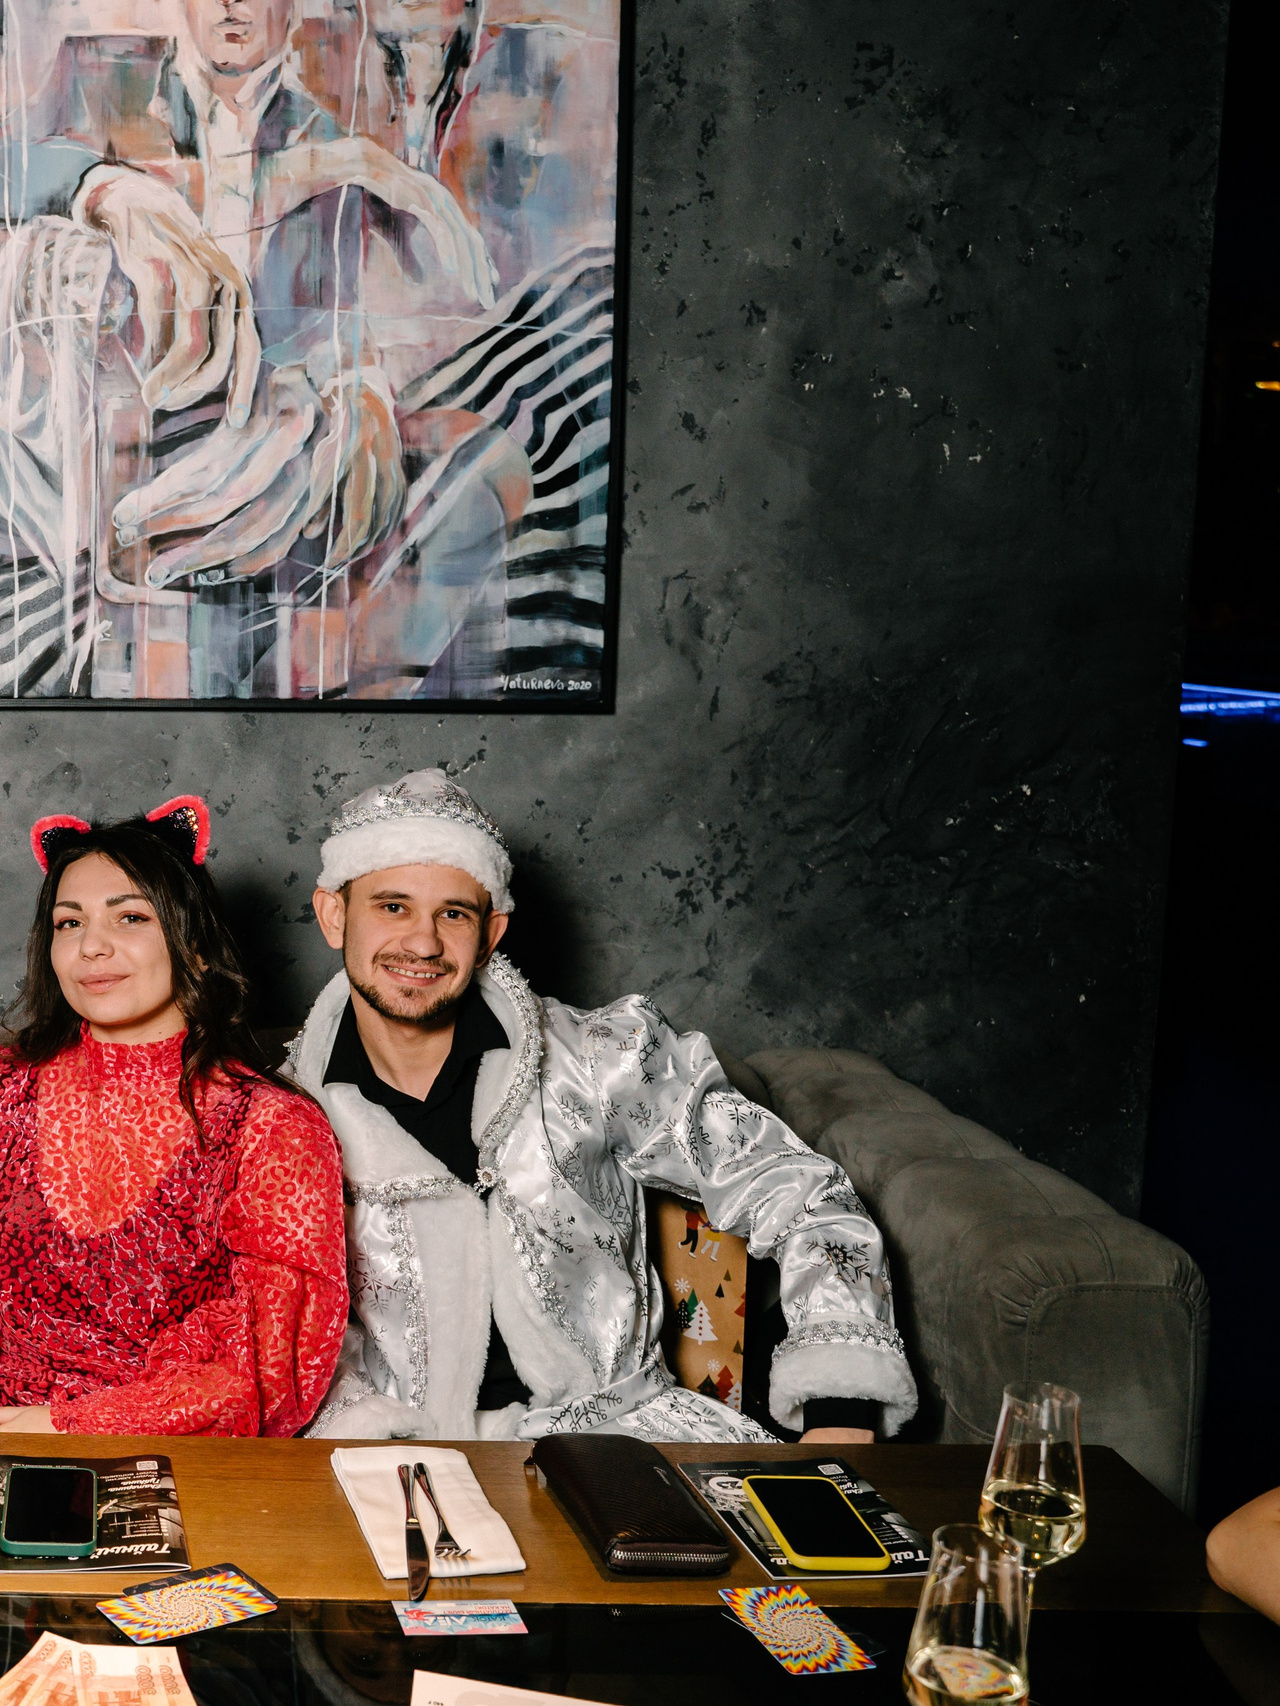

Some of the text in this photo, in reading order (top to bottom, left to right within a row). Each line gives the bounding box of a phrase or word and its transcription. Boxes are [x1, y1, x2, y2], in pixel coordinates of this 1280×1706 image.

[567, 680, 593, 691] 2020
[90, 1543, 171, 1559] Тайный
[890, 1549, 930, 1564] Тай
[135, 1664, 157, 1696] 5000
[159, 1664, 181, 1696] 5000
